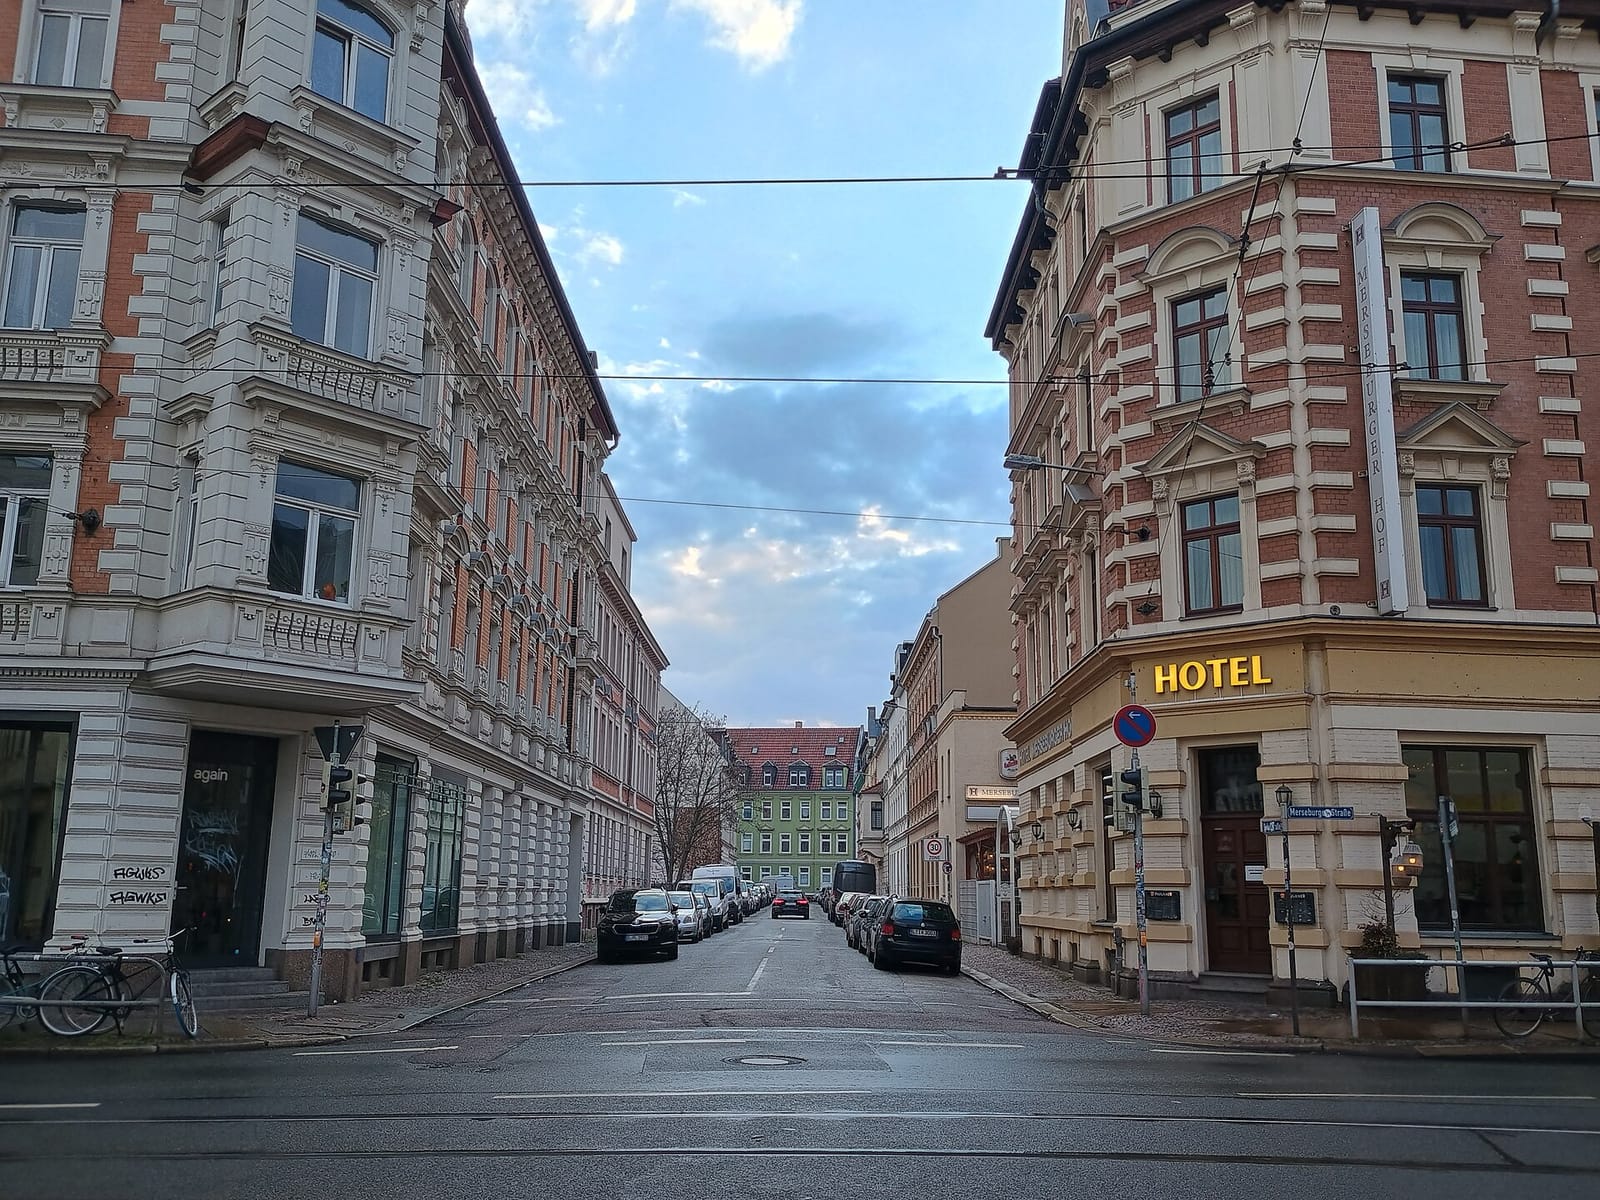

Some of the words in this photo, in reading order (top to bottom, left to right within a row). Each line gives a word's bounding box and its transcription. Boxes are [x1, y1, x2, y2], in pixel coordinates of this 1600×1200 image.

[1357, 267, 1380, 475] MERSEBURGER
[1373, 497, 1385, 554] HOF
[1154, 655, 1272, 694] HOTEL
[193, 768, 228, 783] again
[1331, 808, 1352, 817] Straße
[930, 843, 939, 852] 30
